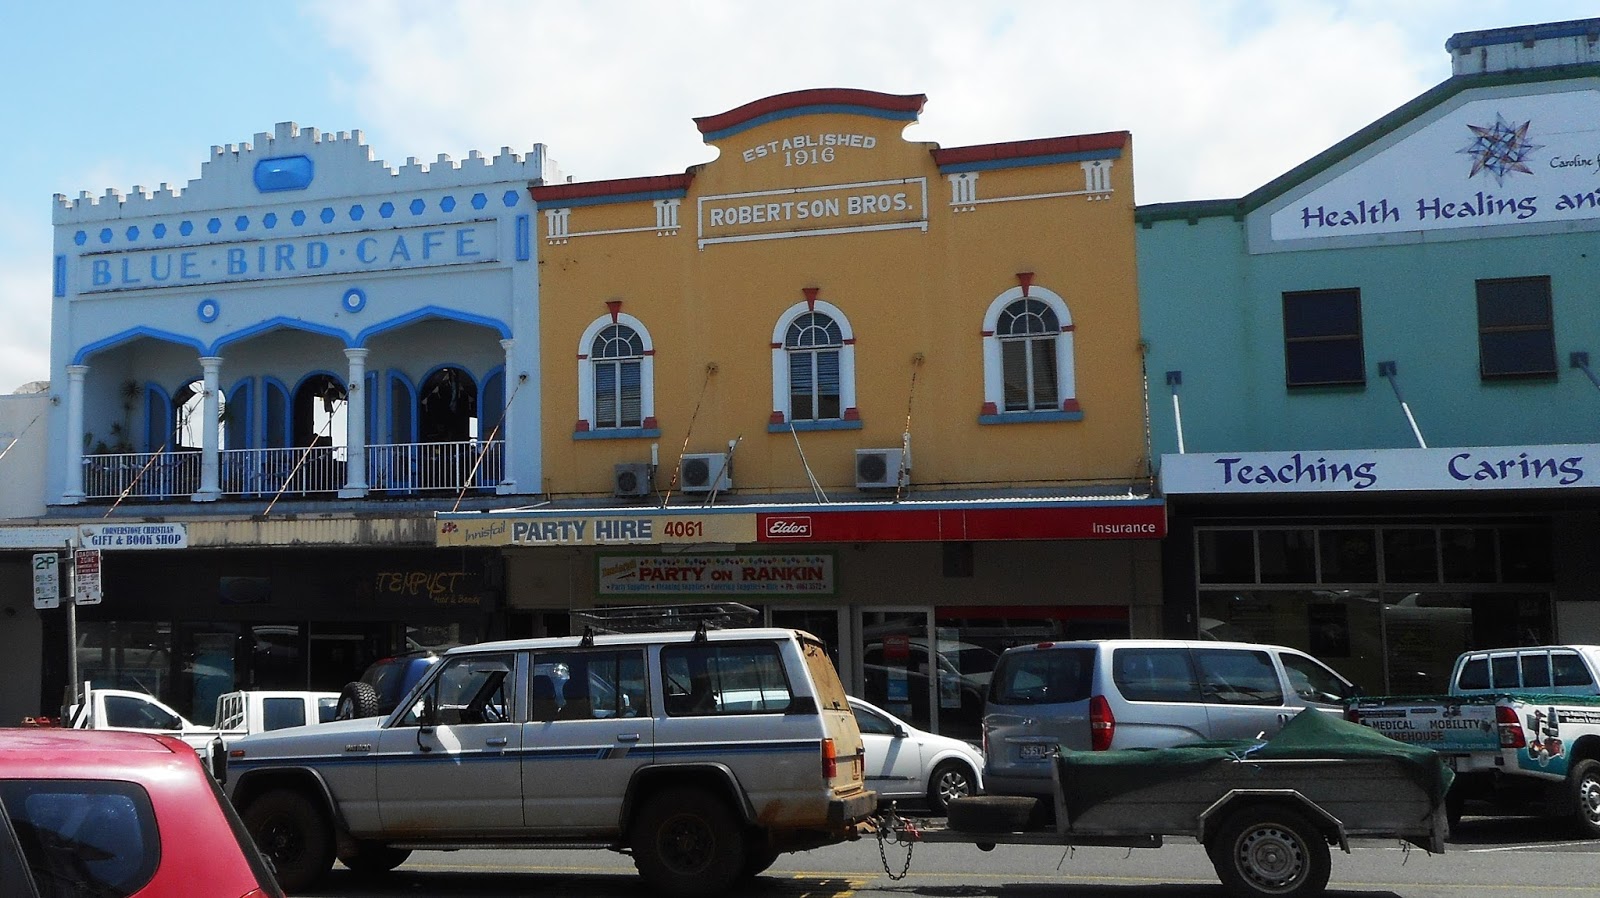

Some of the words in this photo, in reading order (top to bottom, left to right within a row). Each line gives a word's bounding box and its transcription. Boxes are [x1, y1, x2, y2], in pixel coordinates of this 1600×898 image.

[743, 133, 876, 163] ESTABLISHED
[784, 147, 835, 167] 1916
[1550, 154, 1593, 169] Caroline
[710, 198, 840, 227] ROBERTSON
[847, 193, 913, 216] BROS.
[1301, 199, 1400, 229] Health
[1416, 191, 1538, 222] Healing
[92, 252, 201, 286] BLUE
[227, 241, 329, 275] BIRD
[356, 228, 480, 264] CAFE
[1214, 453, 1377, 489] Teaching
[1448, 452, 1584, 486] Caring
[102, 526, 142, 535] CORNERSTONE
[143, 525, 174, 534] CHRISTIAN
[465, 520, 506, 542] Innisfail
[511, 520, 586, 543] PARTY
[593, 519, 652, 542] HIRE
[664, 521, 703, 538] 4061
[769, 521, 808, 534] Elders
[1092, 522, 1156, 534] Insurance
[91, 535, 113, 545] GIFT
[115, 536, 123, 545] &
[126, 535, 153, 545] BOOK
[155, 534, 181, 545] SHOP
[35, 556, 56, 570] 2P
[639, 567, 705, 581] PARTY
[742, 567, 823, 581] RANKIN
[1372, 720, 1415, 730] MEDICAL
[1430, 719, 1480, 729] MOBILITY
